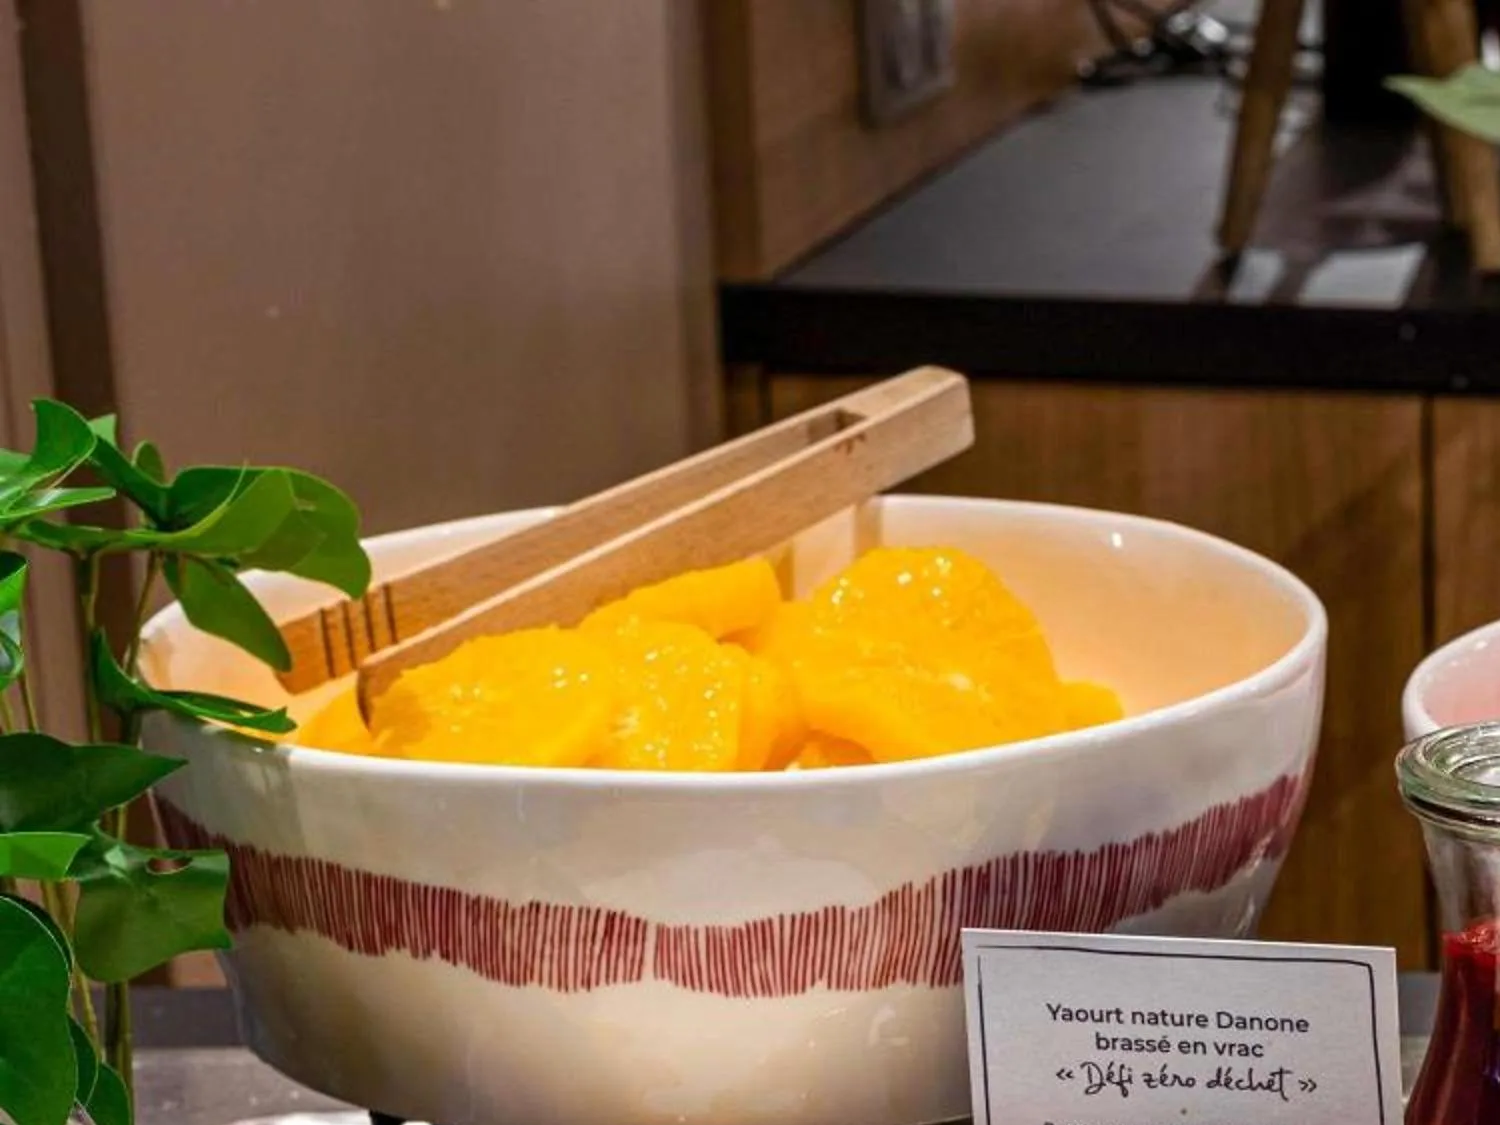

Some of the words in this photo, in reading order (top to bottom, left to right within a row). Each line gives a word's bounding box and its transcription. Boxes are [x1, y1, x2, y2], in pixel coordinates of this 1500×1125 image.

[1046, 1003, 1124, 1024] Yaourt
[1131, 1009, 1208, 1028] nature
[1217, 1011, 1310, 1032] Danone
[1095, 1032, 1171, 1053] brassé
[1178, 1038, 1207, 1055] en
[1214, 1042, 1264, 1058] vrac
[1080, 1061, 1134, 1098] Défi
[1142, 1063, 1197, 1088] zéro
[1206, 1067, 1293, 1101] déchet
